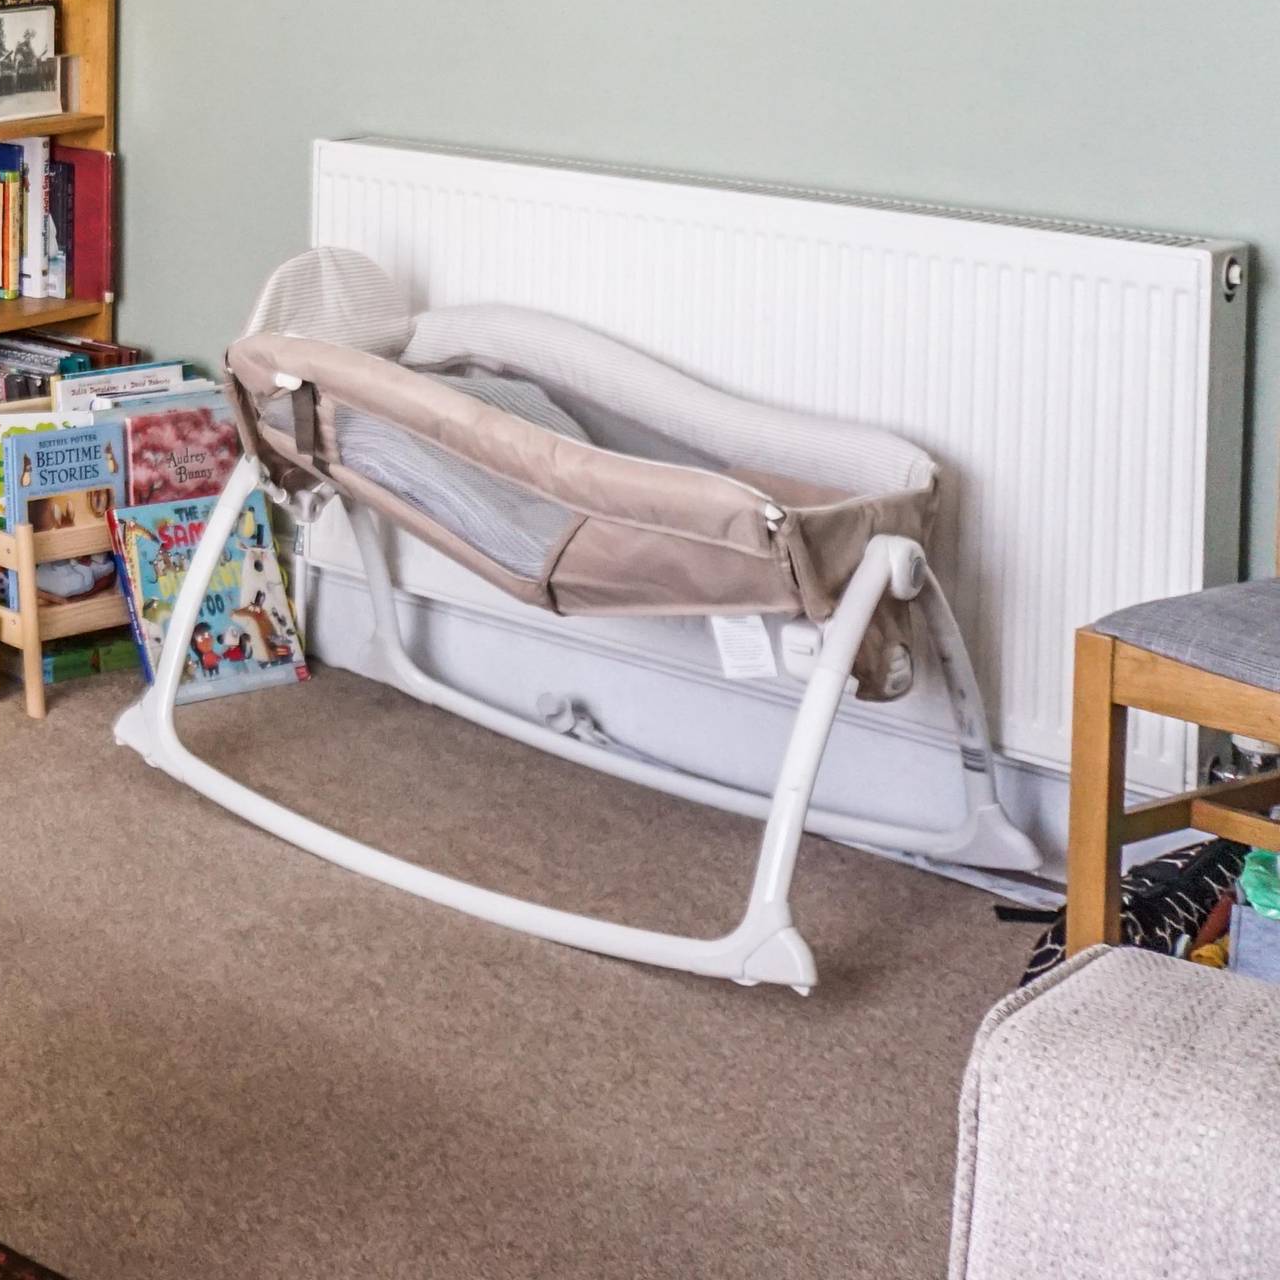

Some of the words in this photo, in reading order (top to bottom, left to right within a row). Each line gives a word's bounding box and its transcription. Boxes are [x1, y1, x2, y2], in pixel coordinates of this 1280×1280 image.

[70, 433, 97, 444] POTTER
[36, 444, 102, 468] BEDTIME
[166, 447, 207, 469] Audrey
[39, 463, 100, 487] STORIES
[176, 465, 214, 484] Bunny
[174, 506, 200, 522] THE
[156, 521, 211, 551] SAM
[198, 593, 225, 618] OO
